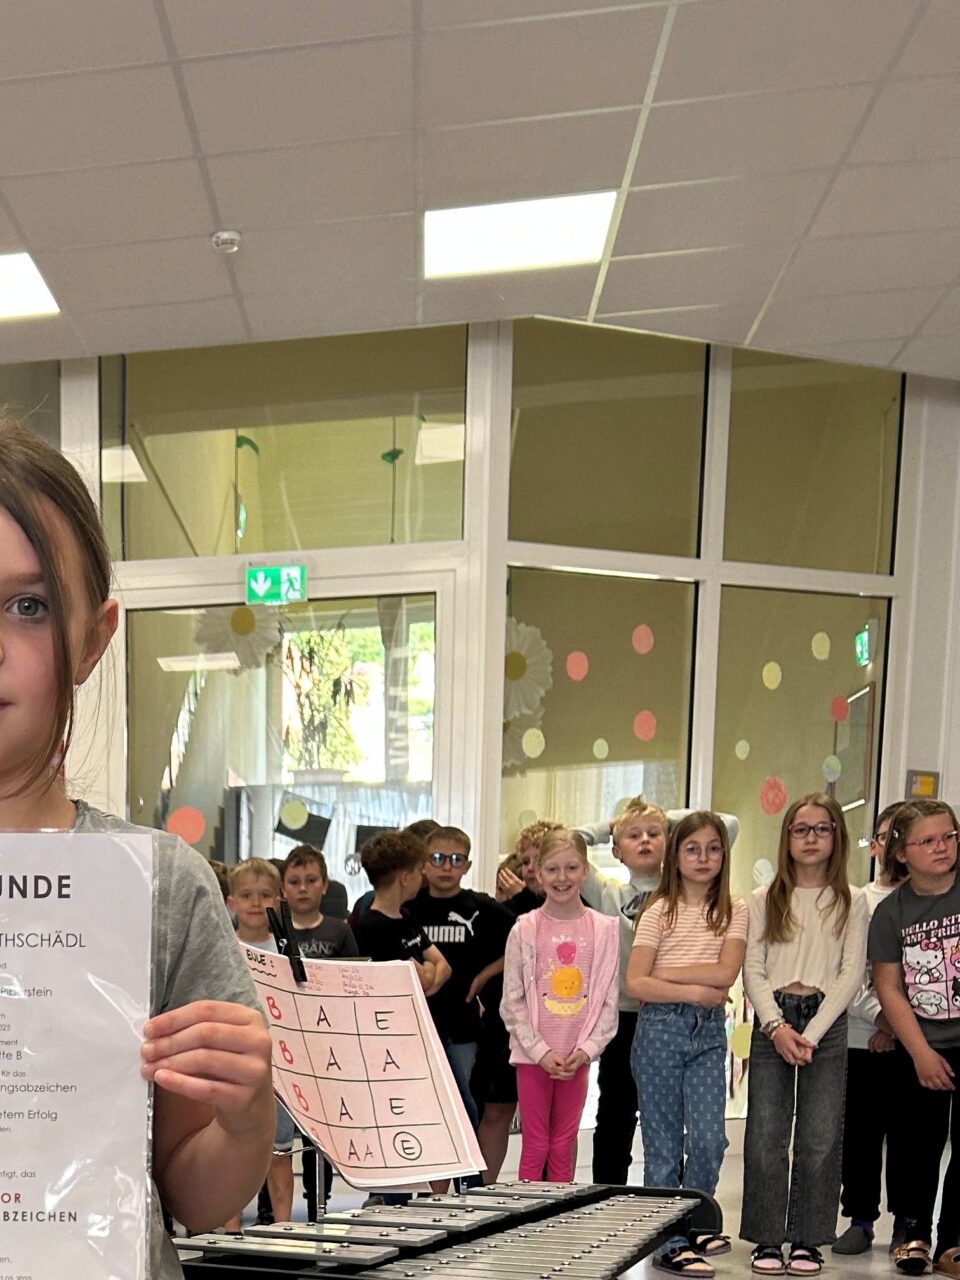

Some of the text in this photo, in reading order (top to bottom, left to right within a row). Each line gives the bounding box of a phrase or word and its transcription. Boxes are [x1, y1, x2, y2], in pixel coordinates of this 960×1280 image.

[423, 926, 465, 942] UMA
[902, 920, 938, 937] HELLO
[904, 924, 960, 944] AND FRIE
[266, 996, 395, 1030] B A E
[16, 1050, 23, 1060] B
[279, 1040, 400, 1072] B A A
[28, 1109, 58, 1122] Erfolg
[340, 1097, 353, 1121] A
[389, 1098, 406, 1115] E
[20, 1169, 37, 1178] das
